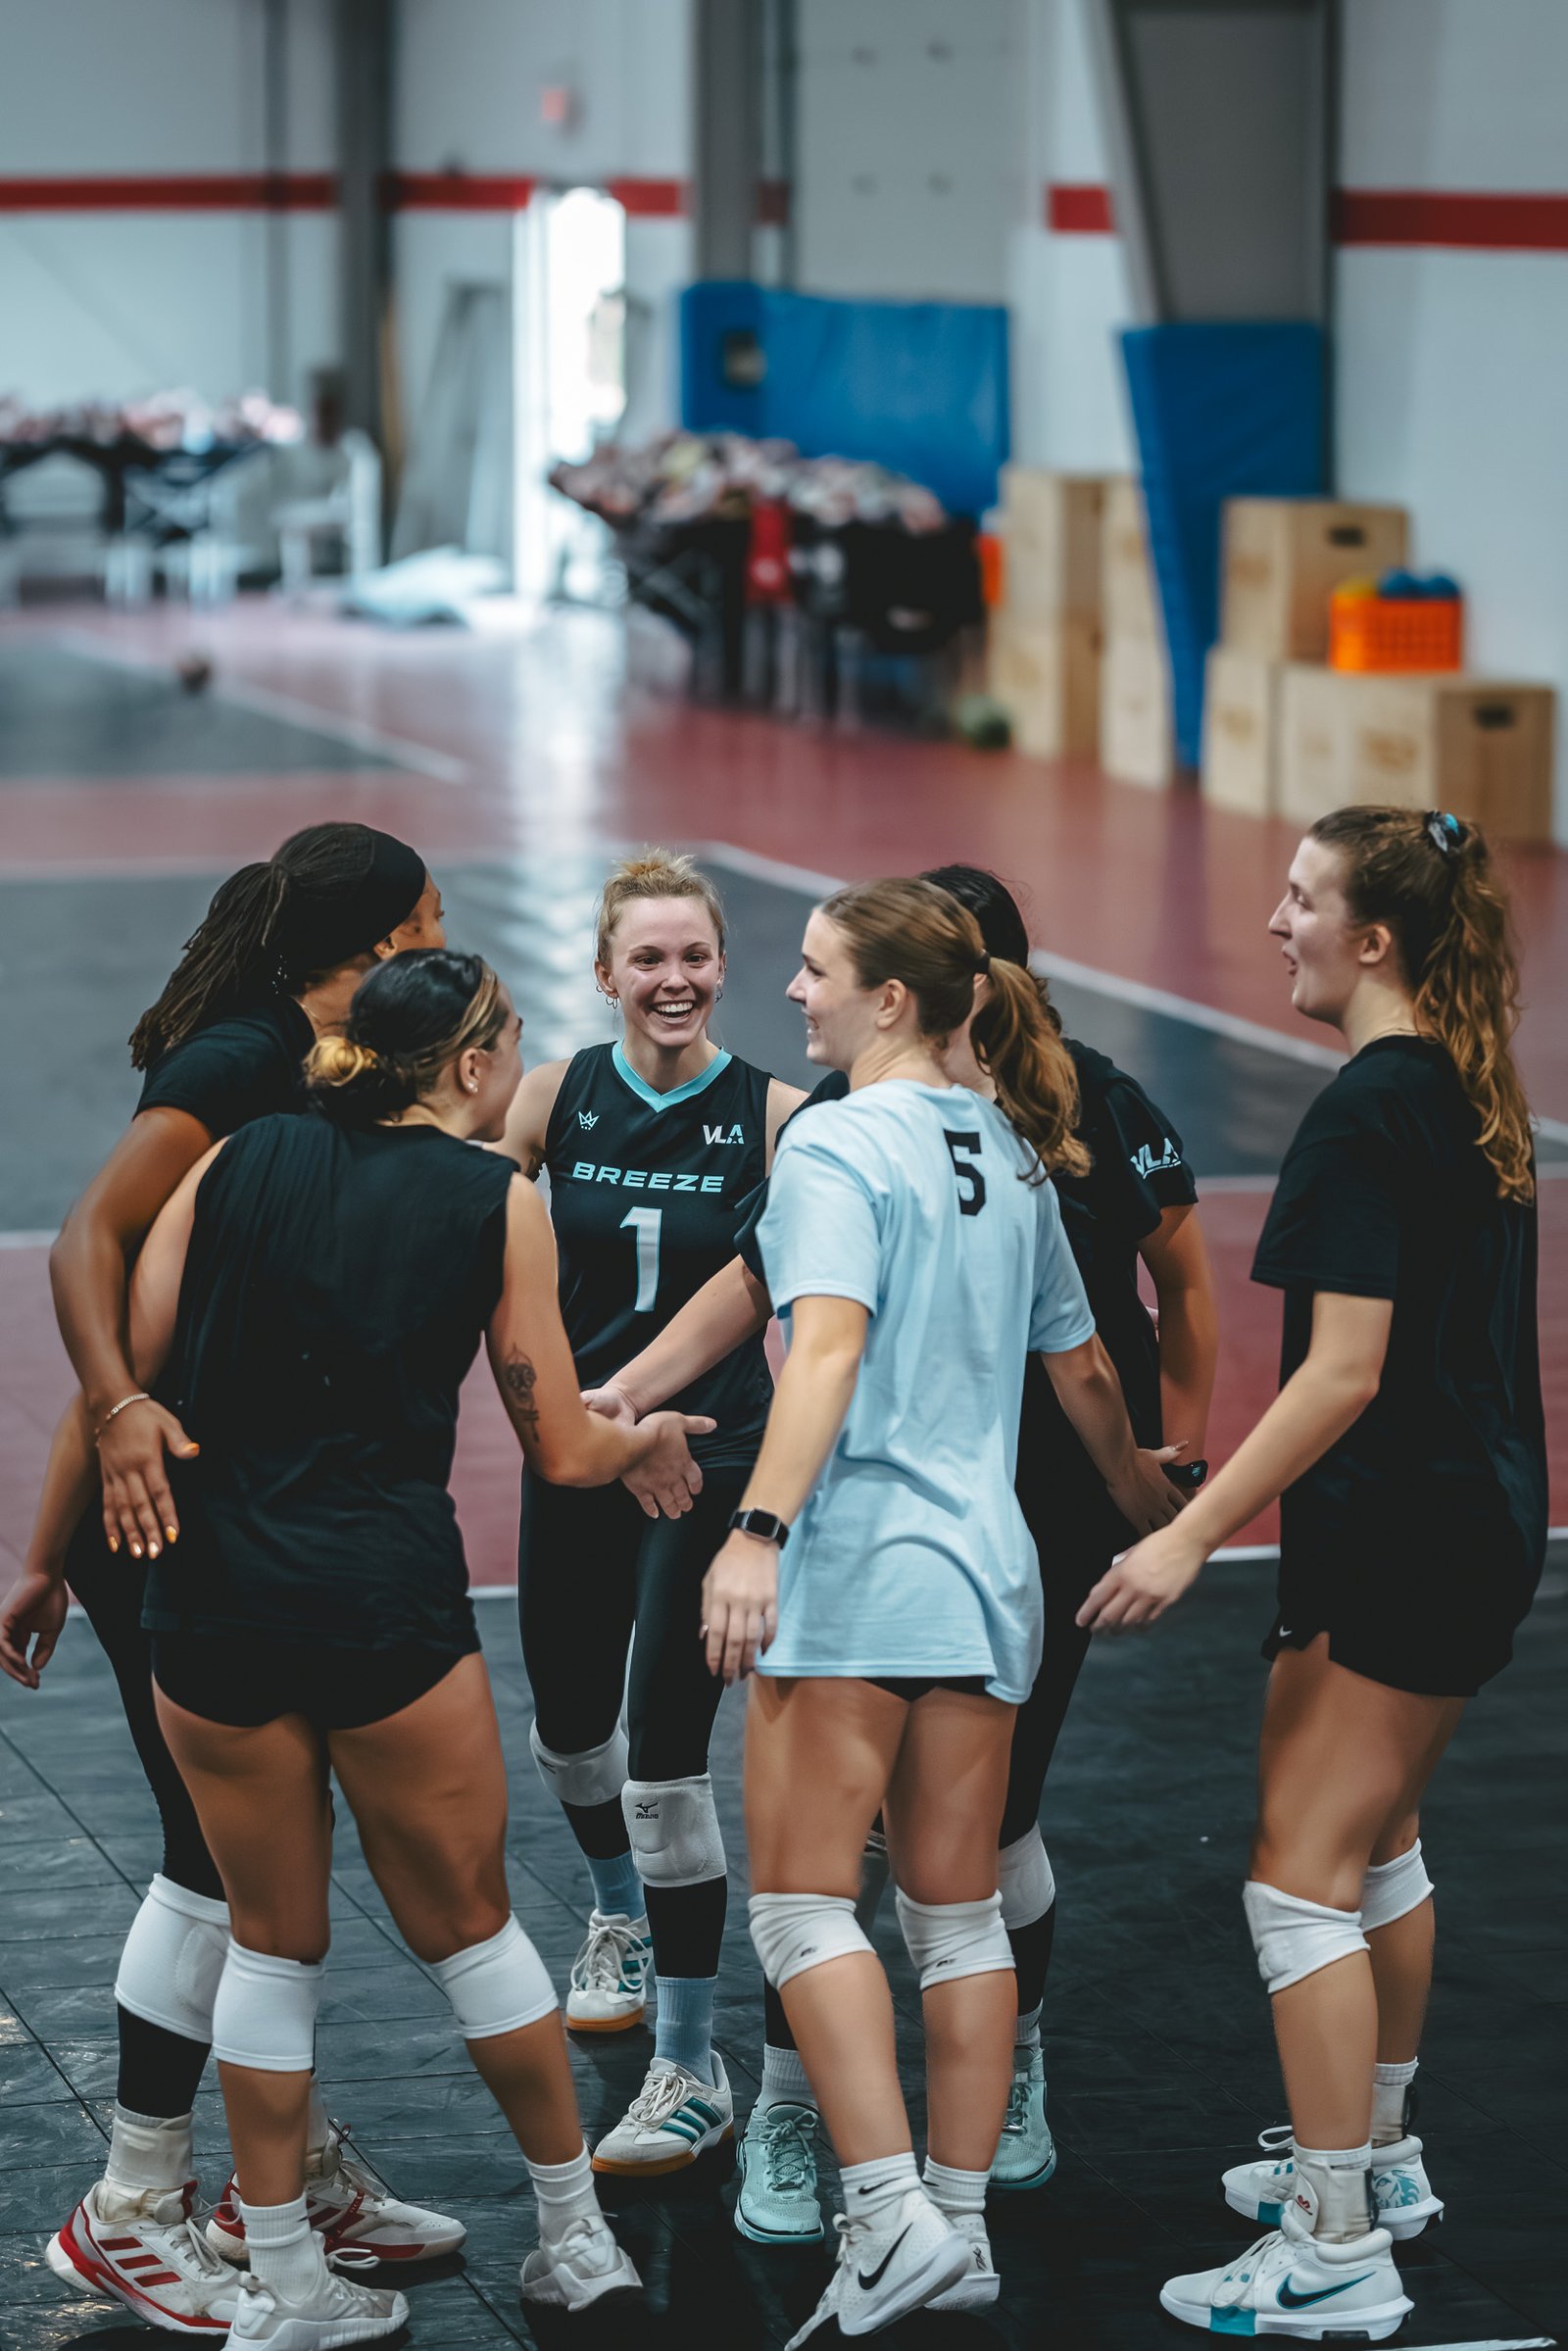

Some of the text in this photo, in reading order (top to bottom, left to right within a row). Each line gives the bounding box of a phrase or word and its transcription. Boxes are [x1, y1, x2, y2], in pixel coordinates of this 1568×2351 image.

[703, 1124, 745, 1145] VLA
[944, 1128, 986, 1216] 5
[1130, 1138, 1180, 1176] VLA
[572, 1161, 724, 1193] BREEZE
[619, 1206, 662, 1312] 1
